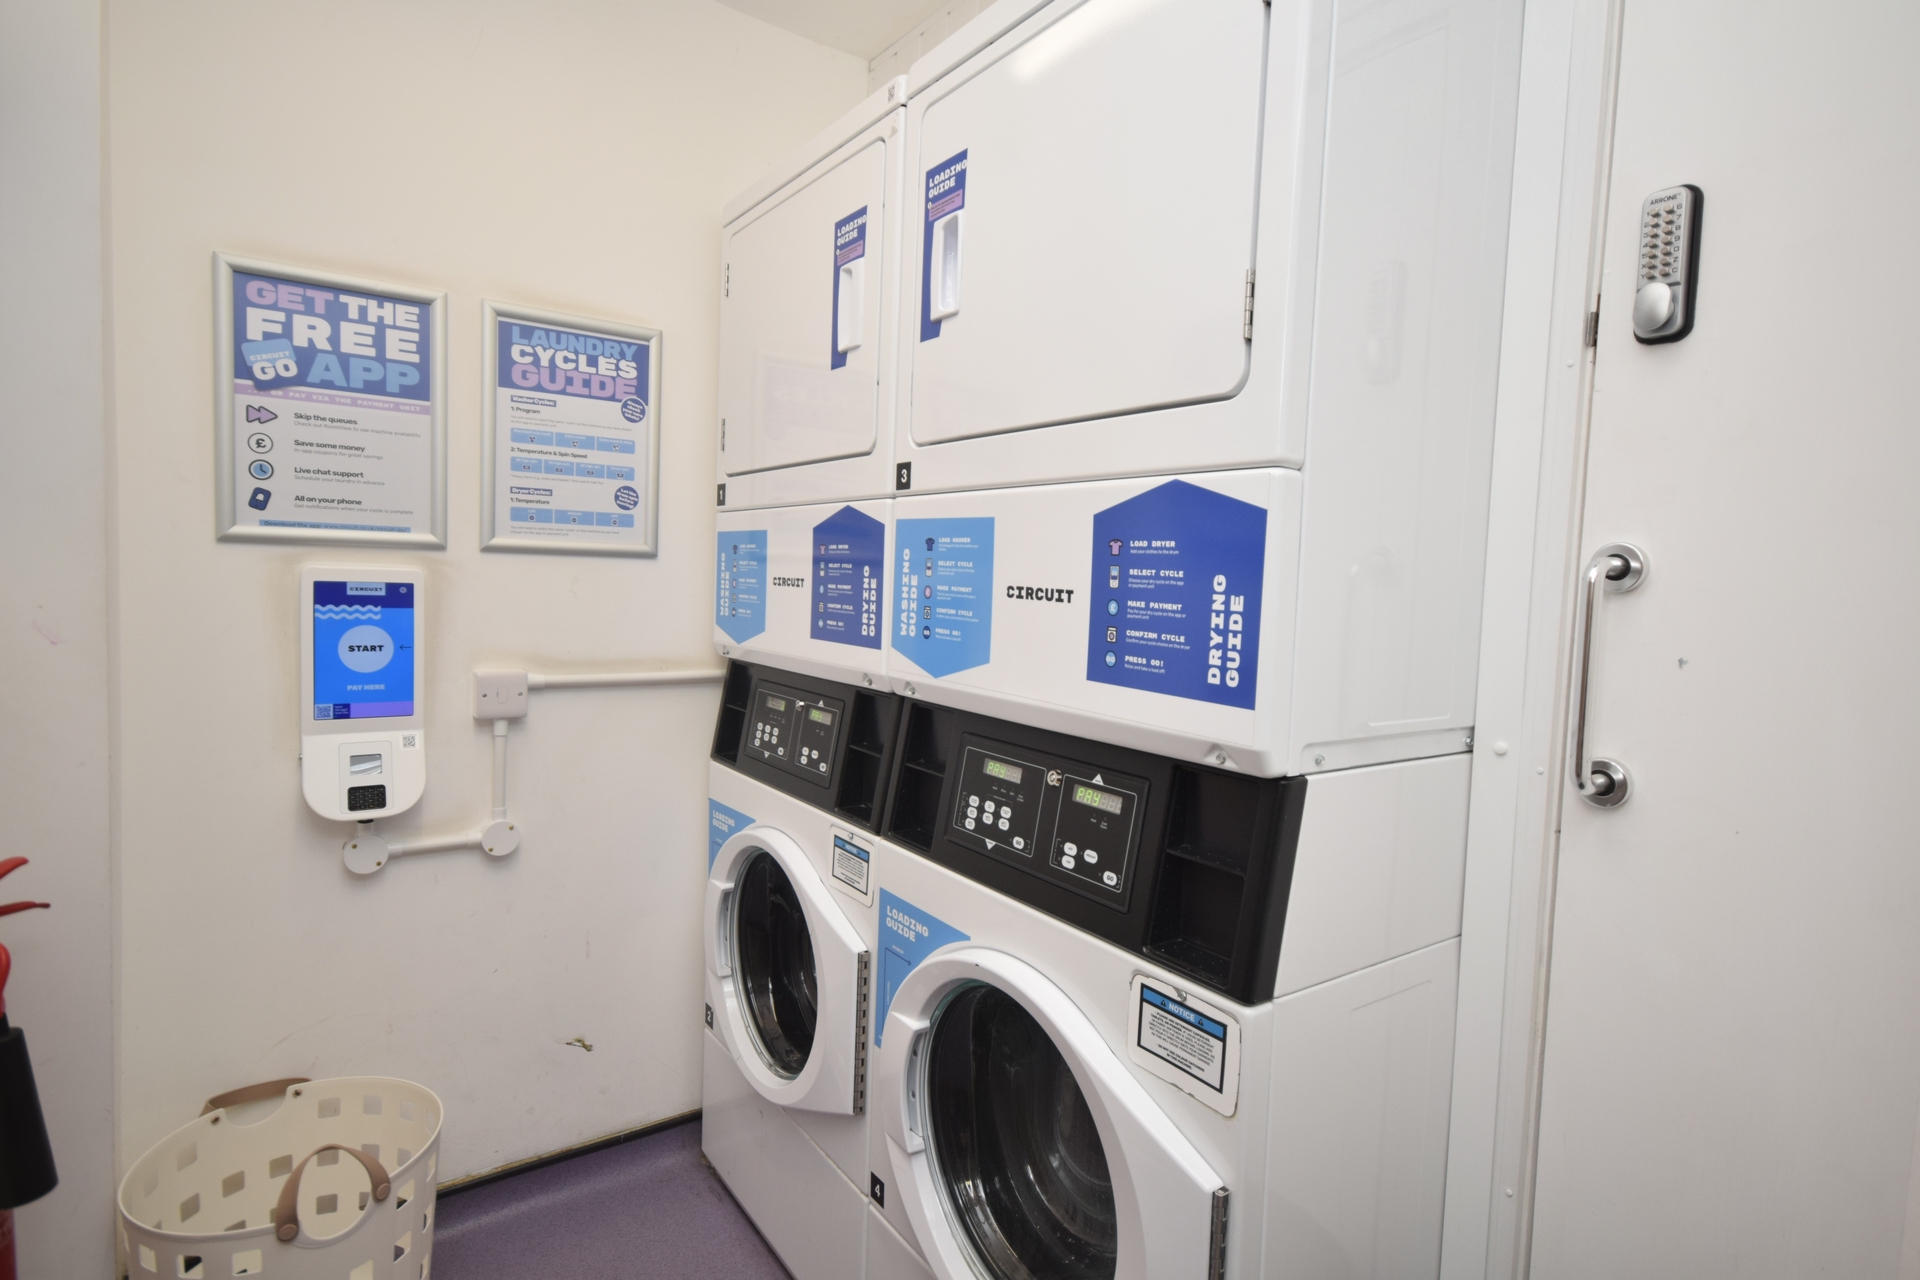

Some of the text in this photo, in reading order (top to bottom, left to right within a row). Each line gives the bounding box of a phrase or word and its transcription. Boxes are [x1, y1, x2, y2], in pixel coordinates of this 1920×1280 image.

[929, 159, 967, 187] LOADING
[928, 176, 956, 198] GUIDE
[837, 214, 867, 237] LOADING
[837, 228, 858, 246] GUIDE
[246, 280, 419, 329] GET THE
[246, 306, 420, 363] FREE
[512, 325, 637, 361] LAUNDRY
[249, 350, 290, 361] CIRCUIT
[511, 344, 637, 379] CYCLES
[252, 357, 298, 380] GO
[306, 352, 420, 393] APP
[511, 363, 637, 399] GUIDE
[357, 400, 394, 410] PAYMENT
[399, 404, 420, 412] UNIT
[294, 412, 358, 425] Skip the queues
[338, 444, 365, 452] money
[517, 447, 552, 456] Temperature
[312, 468, 331, 476] chat
[332, 470, 364, 478] support
[901, 468, 907, 483] 3
[264, 520, 296, 528] Download
[773, 577, 804, 588] CIRCUIT
[1160, 570, 1184, 578] CYCLE
[862, 566, 870, 636] DRYING
[900, 548, 910, 636] WASHING
[1007, 585, 1074, 604] CIRCUIT
[908, 574, 918, 637] GUIDE
[1128, 600, 1182, 610] MAKE PAYMENT
[1126, 630, 1186, 642] CONFIRM CYCLE
[1207, 574, 1226, 685] DRYING
[1225, 595, 1244, 688] GUIDE
[1125, 656, 1164, 666] PRESS GO!
[1076, 787, 1101, 806] PAY
[886, 905, 929, 937] LOADING
[886, 917, 916, 942] GUIDE
[1168, 1003, 1195, 1022] NOTICE
[874, 1184, 880, 1198] 4
